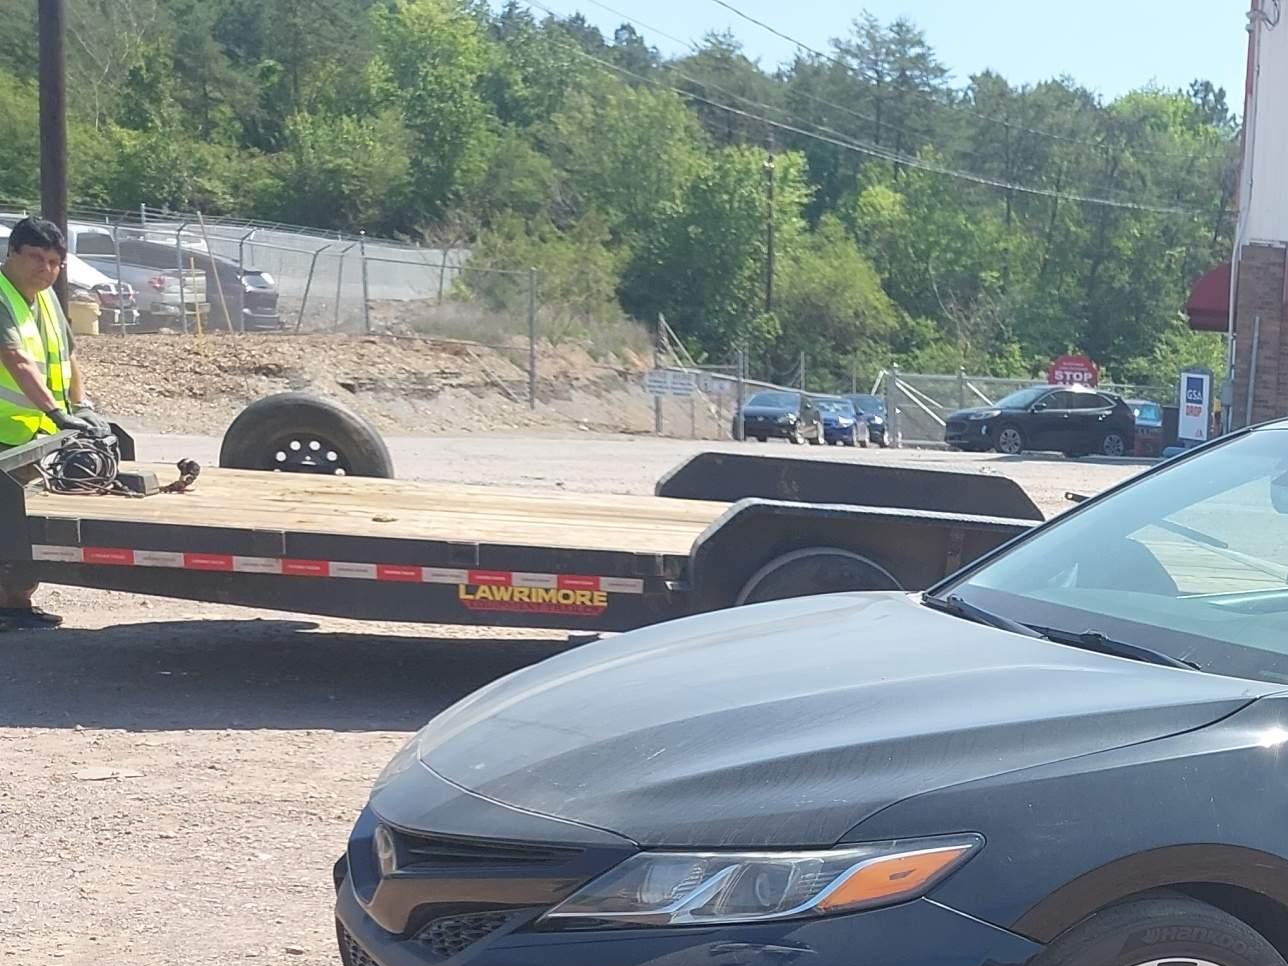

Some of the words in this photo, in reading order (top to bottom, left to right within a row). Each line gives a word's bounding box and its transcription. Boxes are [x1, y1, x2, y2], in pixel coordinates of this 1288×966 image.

[1054, 370, 1093, 382] STOP
[1186, 389, 1203, 401] GSA
[458, 583, 608, 606] LAWRIMORE
